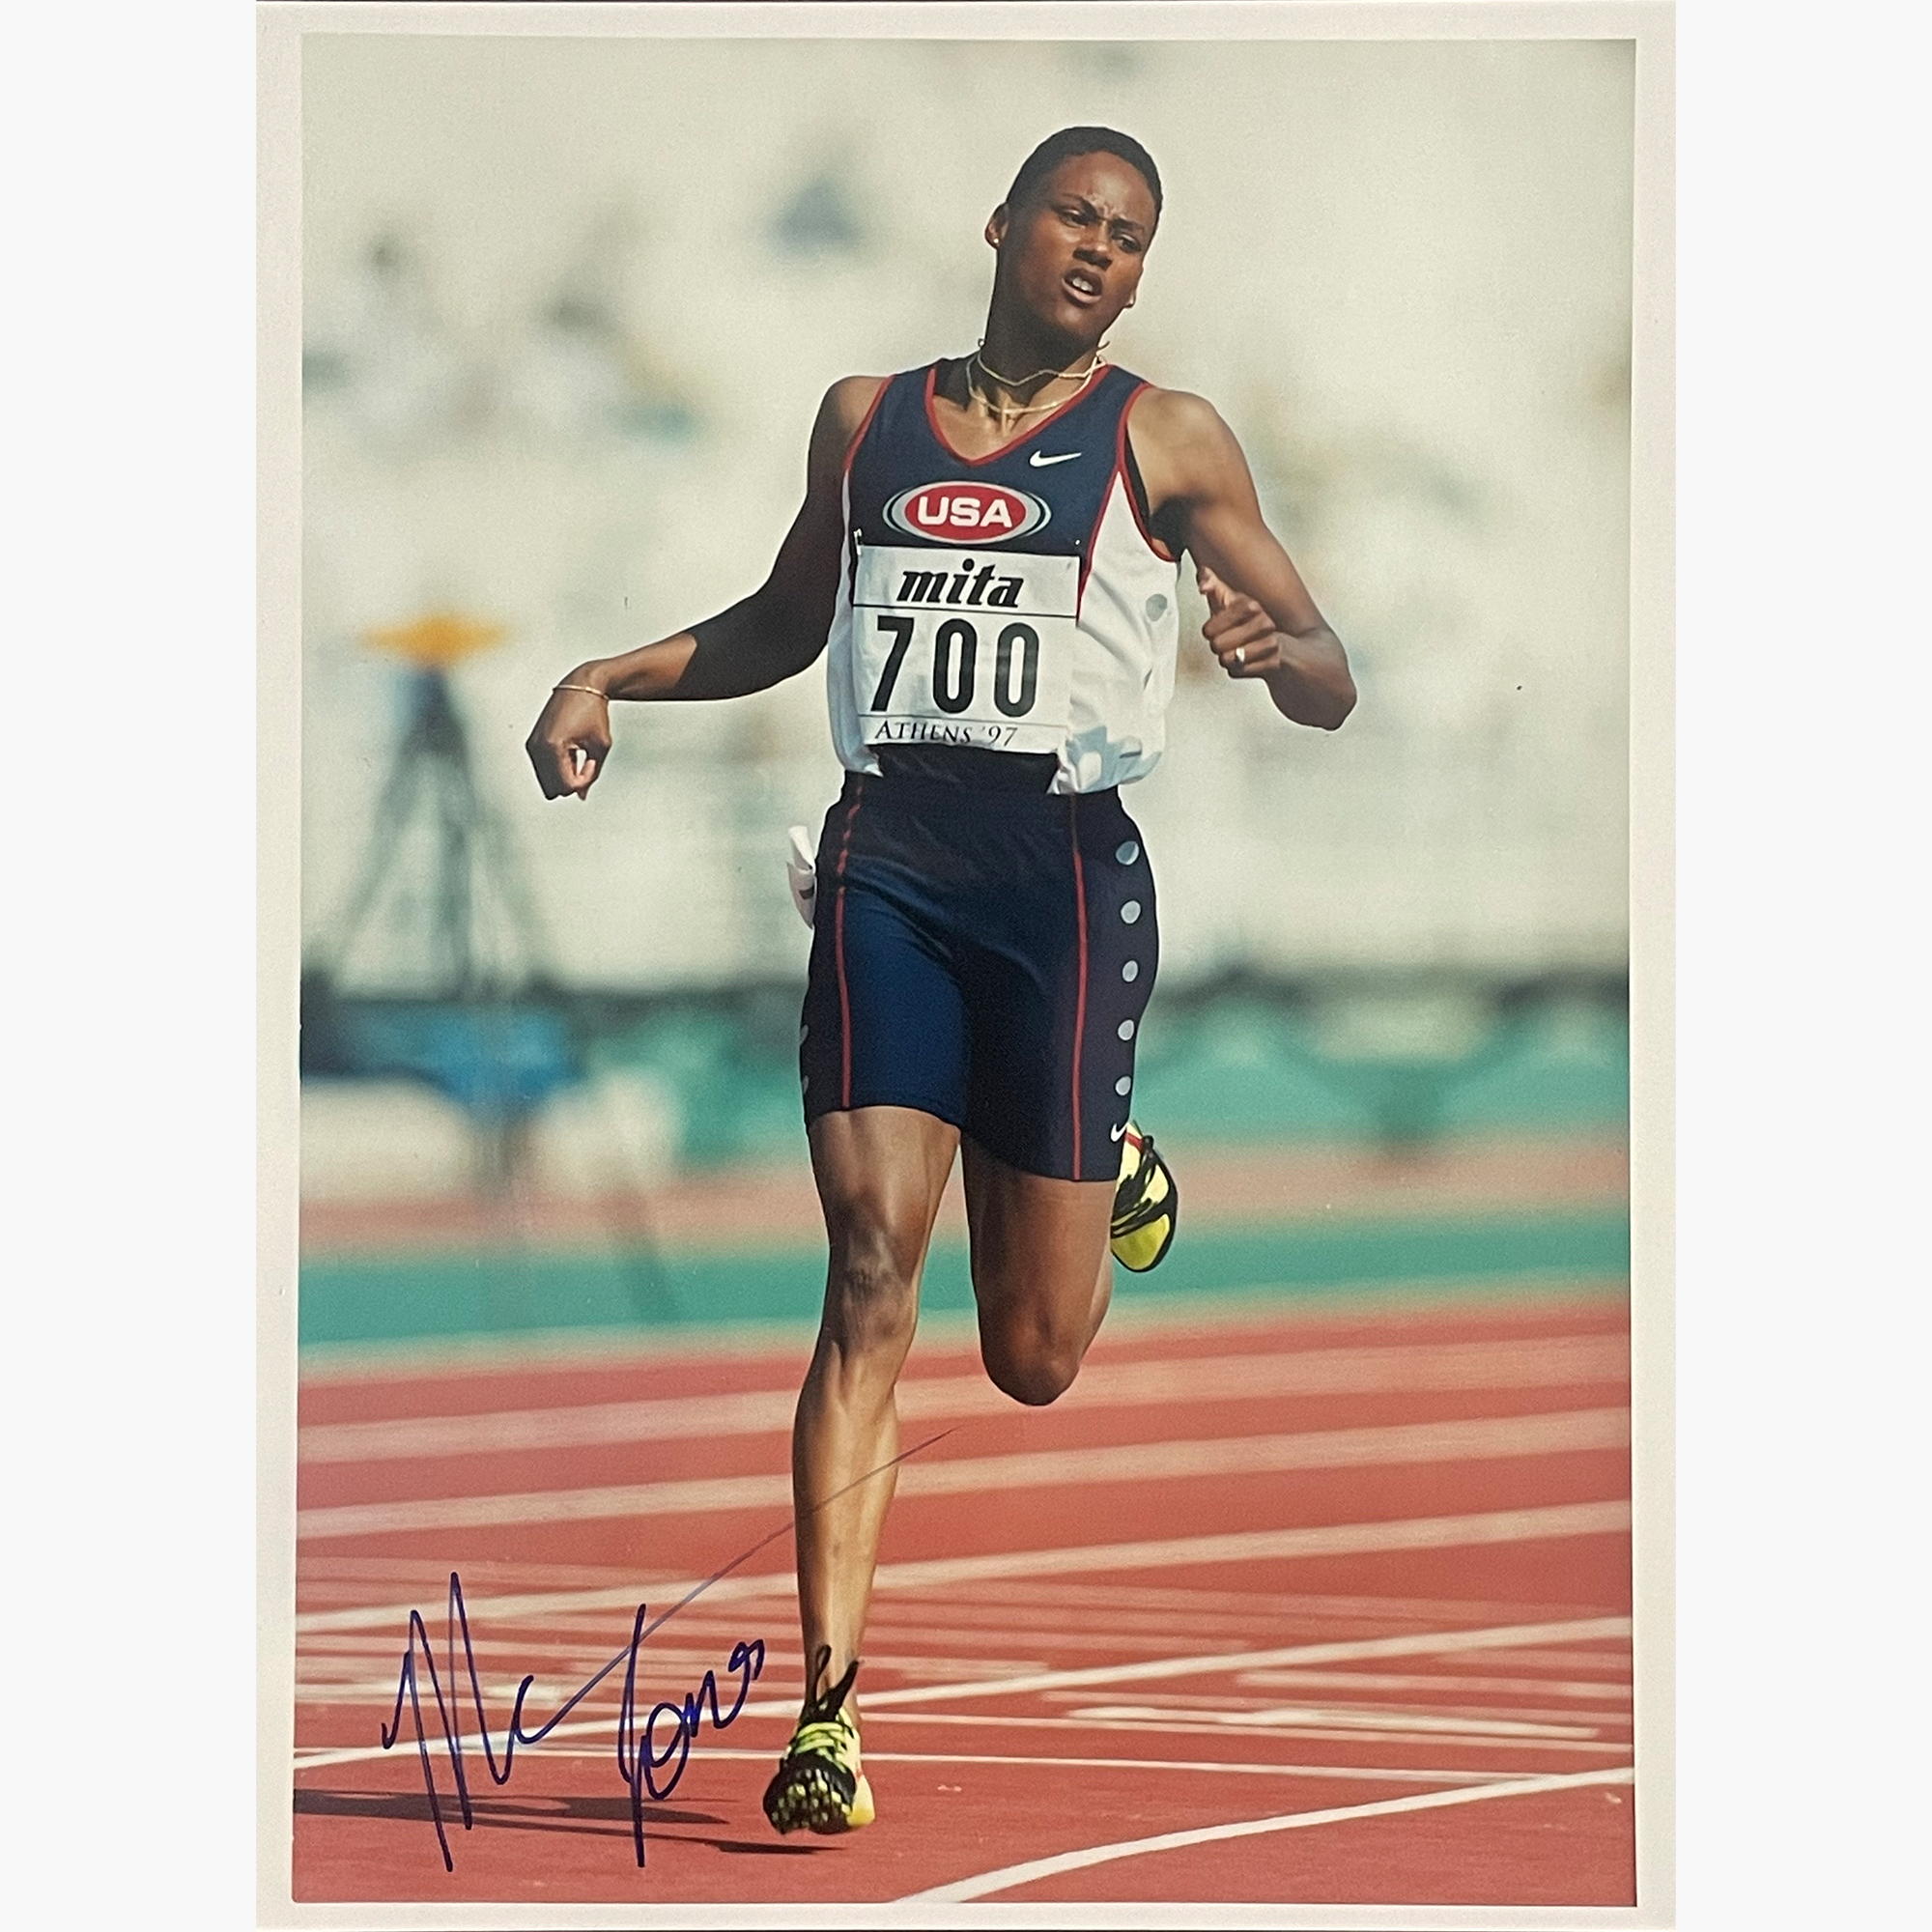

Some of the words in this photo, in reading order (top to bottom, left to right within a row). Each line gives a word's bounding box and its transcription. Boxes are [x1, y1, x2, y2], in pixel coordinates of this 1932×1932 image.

[917, 497, 1013, 527] USA
[896, 558, 1024, 608] mita
[870, 615, 1039, 718] 700
[874, 720, 972, 744] ATHENS
[982, 725, 1018, 747] '97
